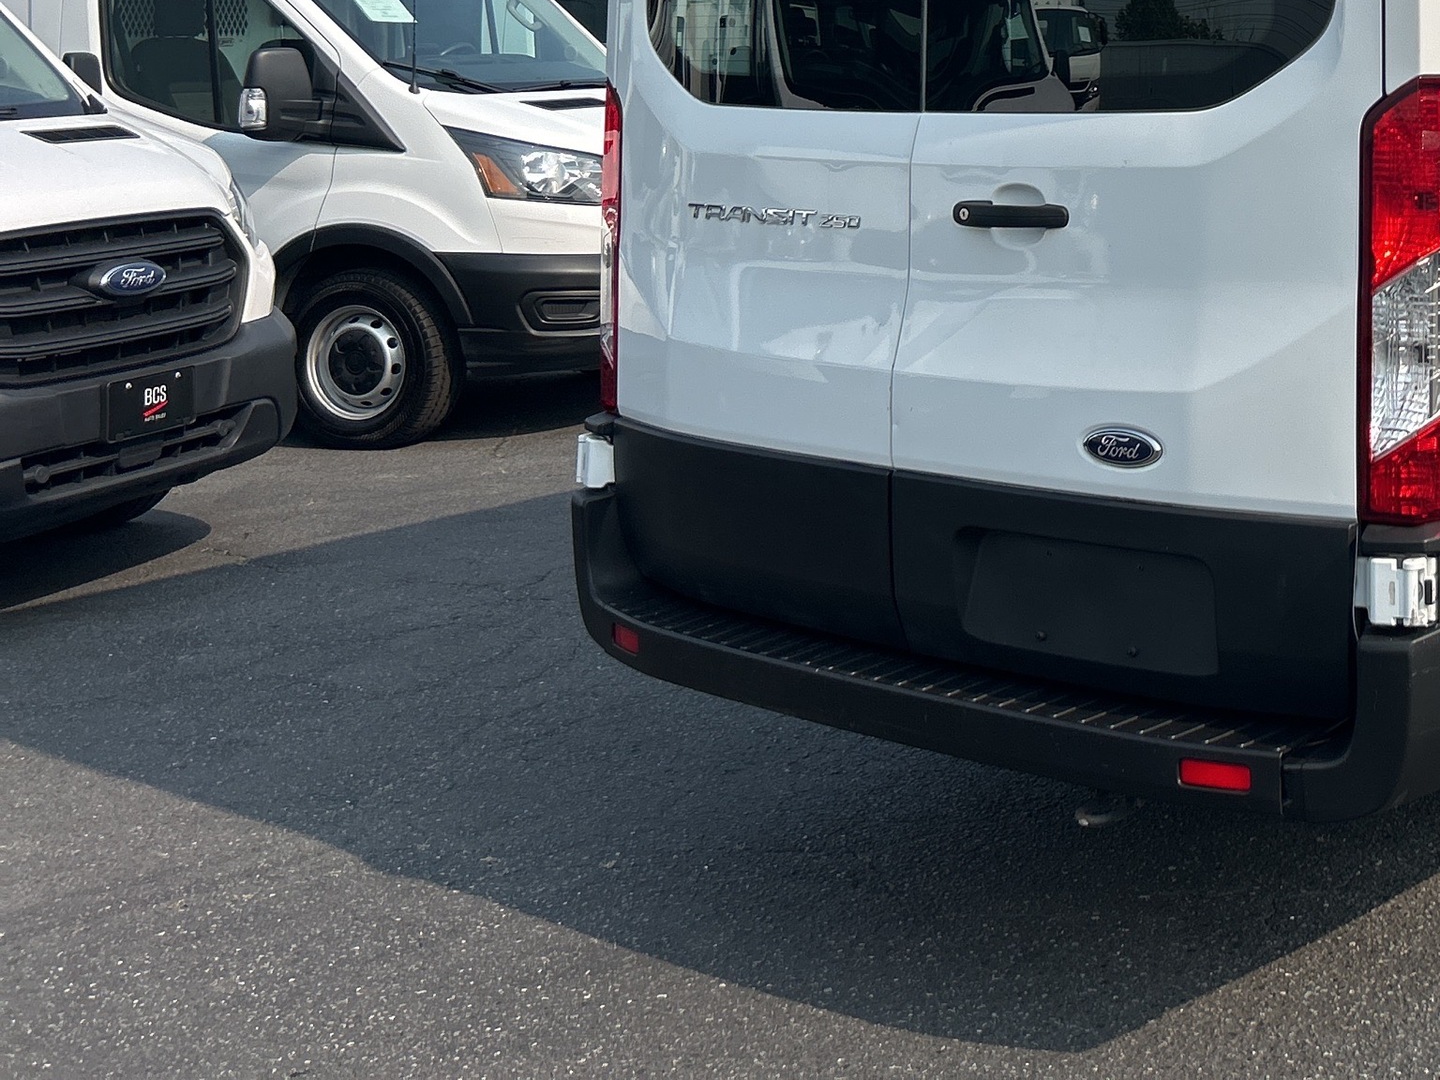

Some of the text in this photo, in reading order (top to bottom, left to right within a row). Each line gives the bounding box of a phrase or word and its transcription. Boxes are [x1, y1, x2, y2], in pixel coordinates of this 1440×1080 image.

[688, 203, 861, 229] TRANSIT 250
[120, 267, 156, 288] Ford
[144, 384, 167, 406] BCS
[1097, 434, 1141, 459] Ford
